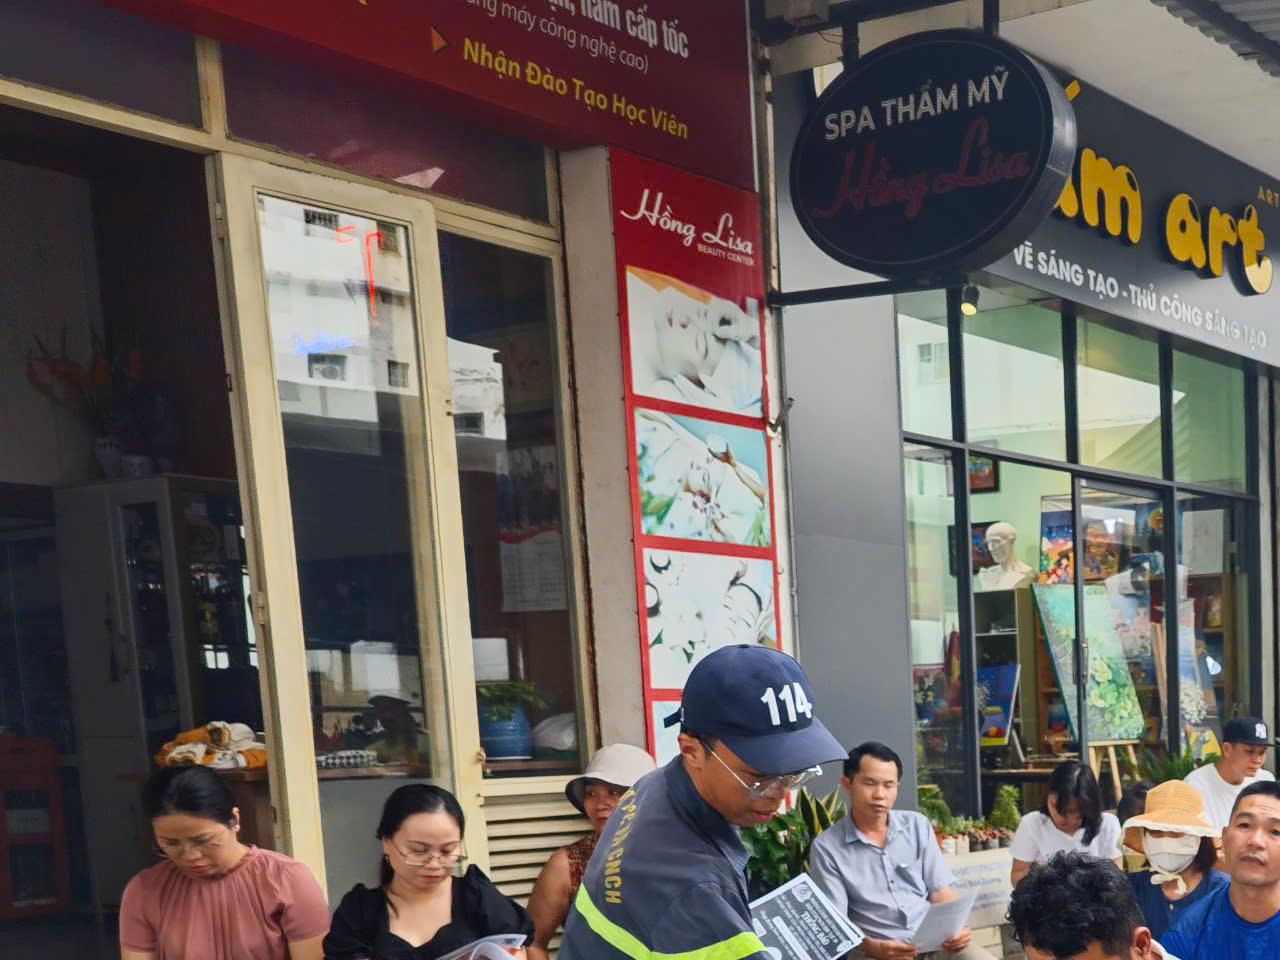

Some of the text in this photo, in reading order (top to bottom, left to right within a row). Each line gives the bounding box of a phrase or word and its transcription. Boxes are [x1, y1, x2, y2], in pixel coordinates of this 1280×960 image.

[501, 4, 536, 31] máy
[540, 17, 577, 48] công
[580, 32, 617, 63] nghệ
[619, 48, 649, 74] cao)
[625, 4, 659, 49] cấp
[662, 19, 689, 58] tốc
[463, 37, 688, 139] Nhận Đào Tạo Học Viên
[824, 64, 1009, 141] SPA THẨM MỸ
[932, 118, 1030, 194] Lisa
[619, 188, 754, 255] Hồng Lisa
[1258, 185, 1280, 208] ART
[697, 243, 755, 266] BEAUTY CENTER
[1165, 192, 1273, 294] art
[1037, 249, 1085, 287] SÁNG
[1087, 268, 1120, 300] TẠO
[1160, 293, 1201, 328] CÔNG
[1205, 310, 1240, 341] SÁNG
[1242, 326, 1267, 351] TẠO
[760, 682, 813, 726] 114
